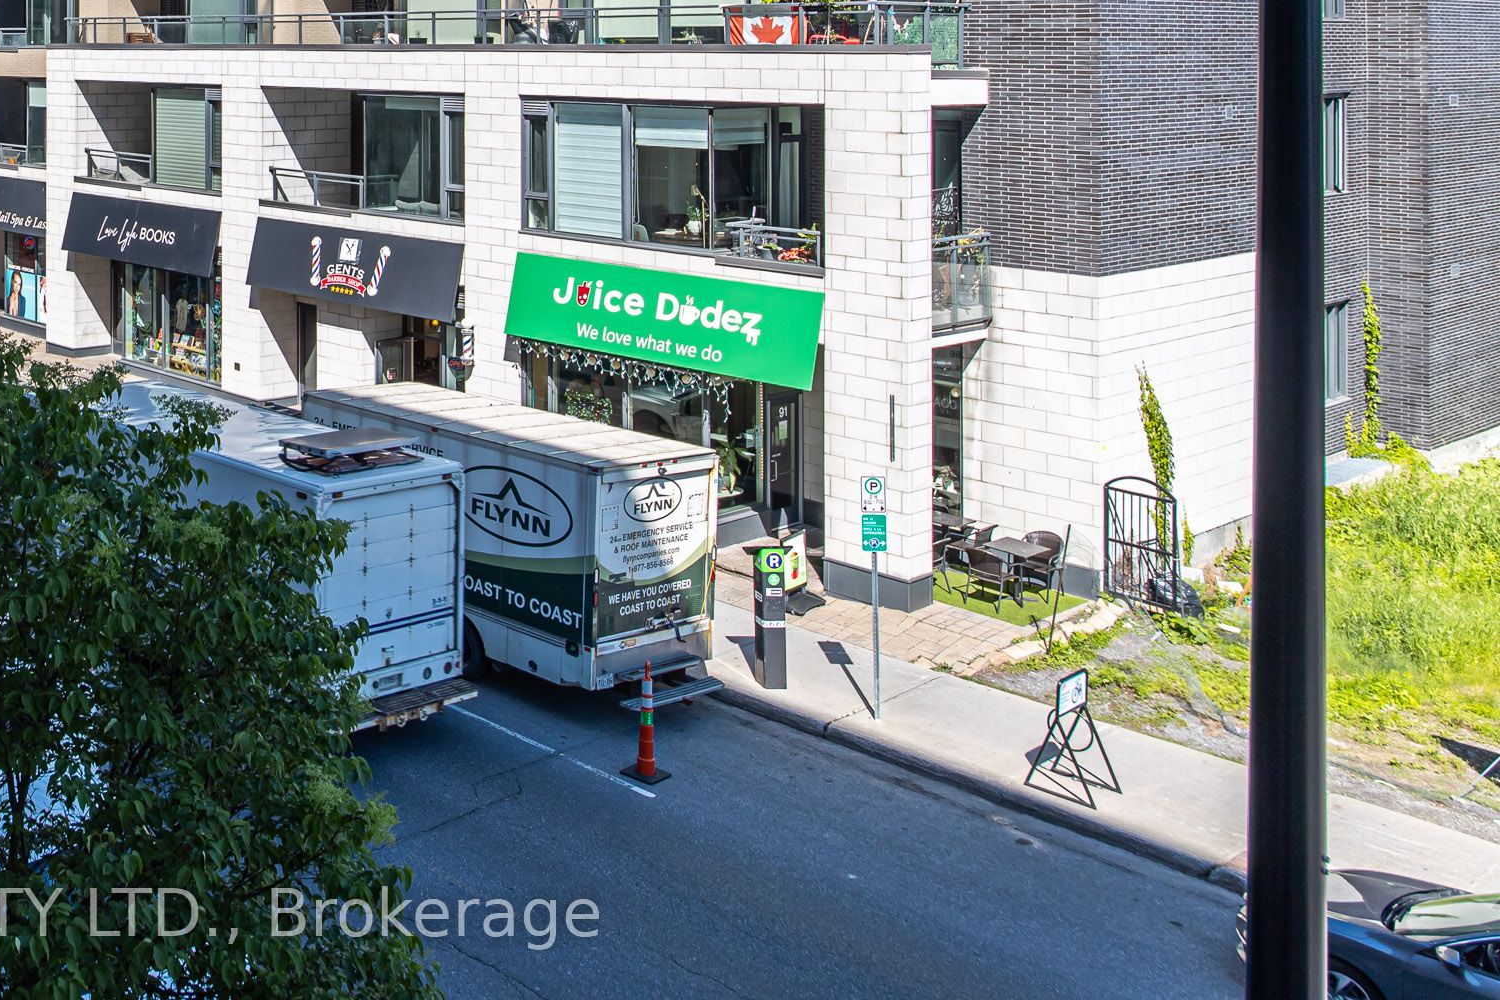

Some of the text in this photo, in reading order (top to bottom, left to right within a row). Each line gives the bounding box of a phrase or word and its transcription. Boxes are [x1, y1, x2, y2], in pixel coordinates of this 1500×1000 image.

[10, 213, 23, 228] Spa
[25, 215, 32, 227] &
[33, 216, 46, 230] Las
[97, 215, 118, 241] Love
[139, 227, 176, 244] BOOKS
[326, 263, 365, 280] GENTS
[327, 275, 361, 287] BARBER SHOP
[576, 322, 723, 362] We love what we do
[778, 405, 788, 418] 91
[869, 481, 878, 491] P
[634, 498, 672, 515] FLYNN
[472, 497, 550, 538] FLYNN
[622, 526, 665, 542] EMERGENCY
[665, 521, 693, 534] SERVICE
[613, 533, 689, 554] & ROOF MAINTENANCE
[622, 547, 680, 565] flynncompanies.com
[464, 574, 582, 629] OAST TO COAST
[608, 579, 692, 605] WE HAVE YOU COVERED
[619, 594, 681, 616] COAST TO COAST
